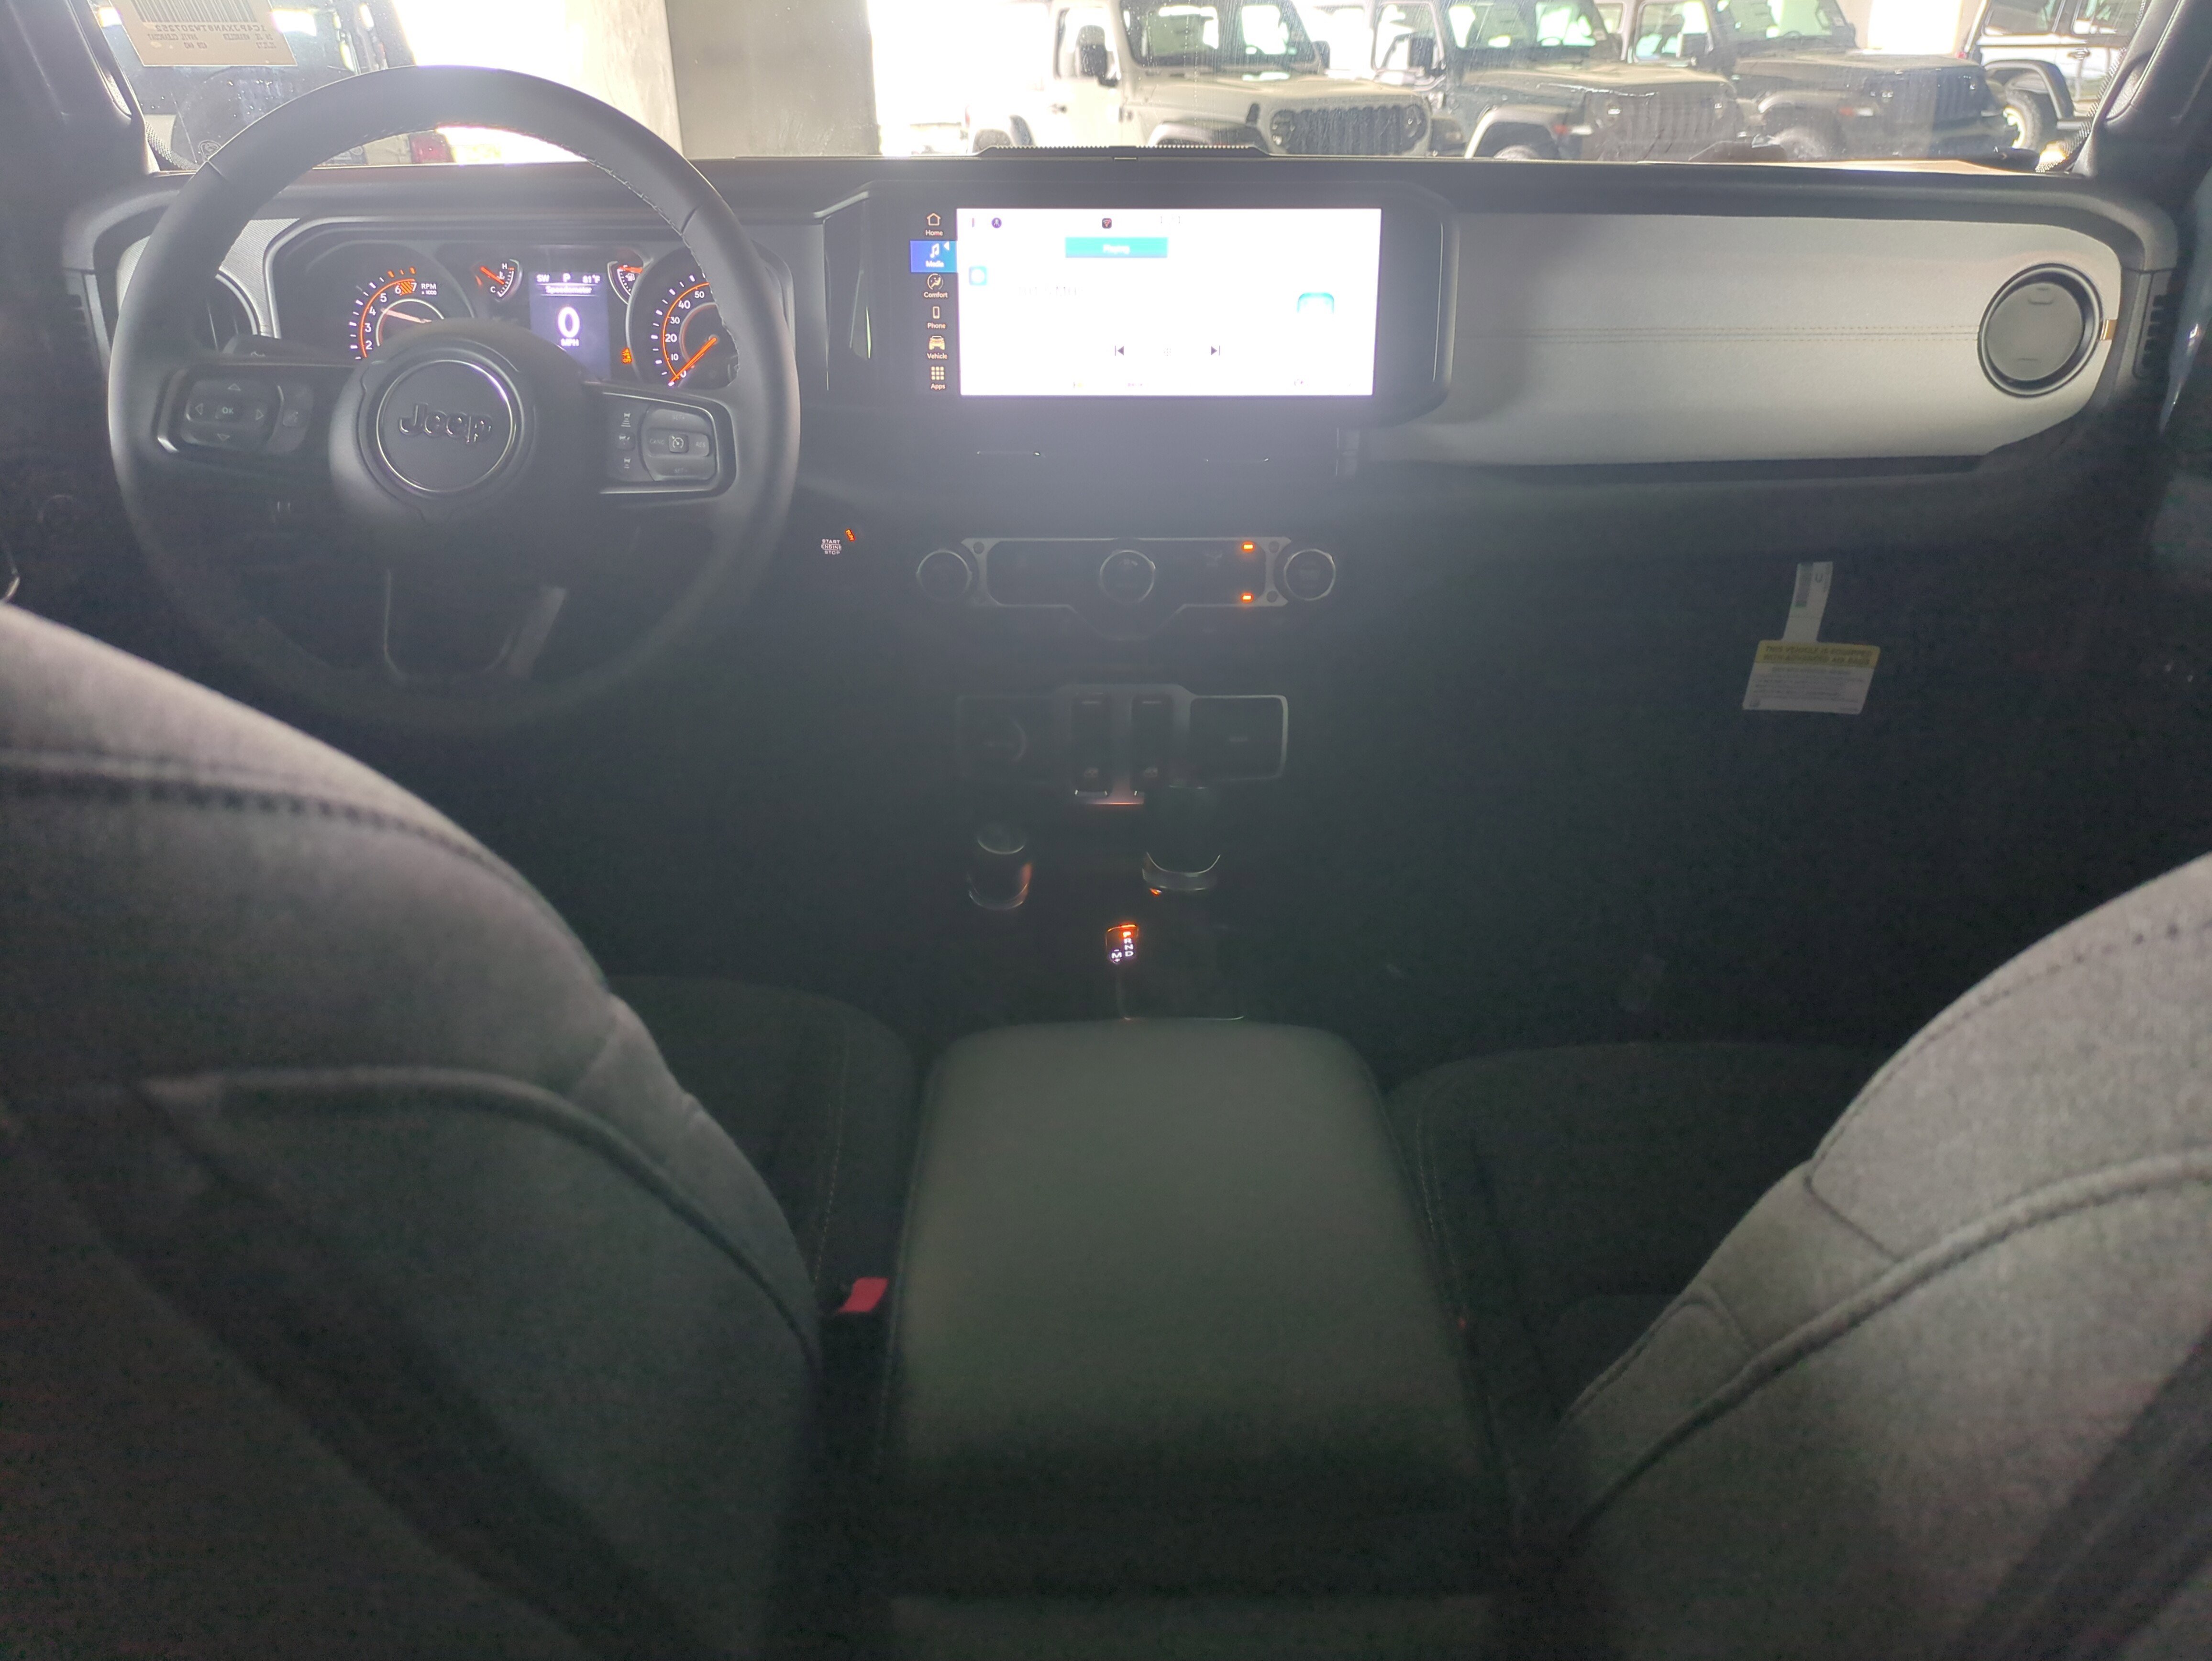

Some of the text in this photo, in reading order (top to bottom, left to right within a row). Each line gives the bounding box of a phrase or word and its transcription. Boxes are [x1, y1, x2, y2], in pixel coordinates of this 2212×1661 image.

[536, 275, 550, 283] SW
[563, 273, 571, 282] P
[395, 285, 401, 294] 6
[411, 282, 417, 291] 7
[380, 293, 387, 303] 5
[694, 290, 705, 299] 50
[678, 300, 691, 309] 40
[369, 307, 376, 316] 4
[557, 306, 580, 338] 0
[670, 317, 680, 325] 30
[365, 323, 372, 332] 3
[664, 334, 677, 343] 20
[365, 341, 373, 350] 2
[399, 403, 493, 444] Jeep
